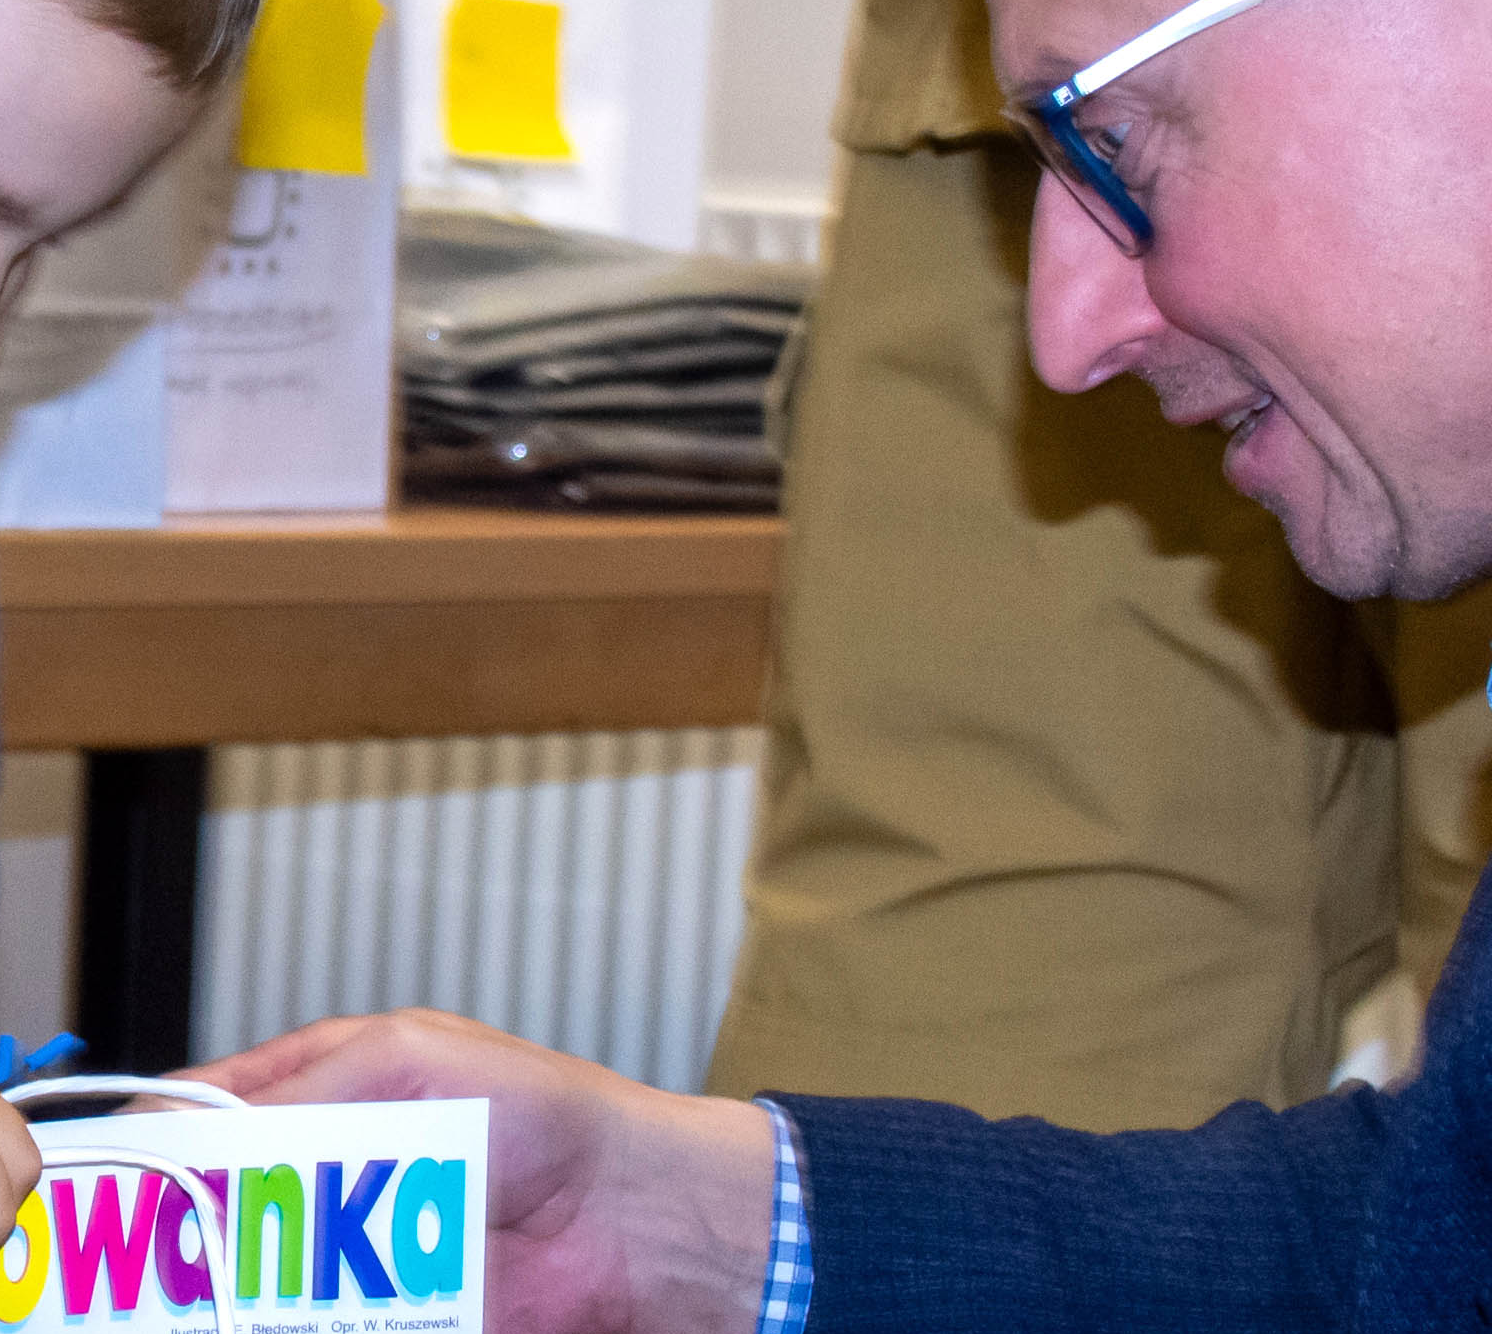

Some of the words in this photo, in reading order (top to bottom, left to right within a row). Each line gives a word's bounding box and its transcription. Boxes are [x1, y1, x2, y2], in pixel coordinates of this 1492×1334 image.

[330, 1320, 359, 1334] Opr.
[363, 1319, 381, 1332] W.
[384, 1315, 460, 1332] Kruszewski
